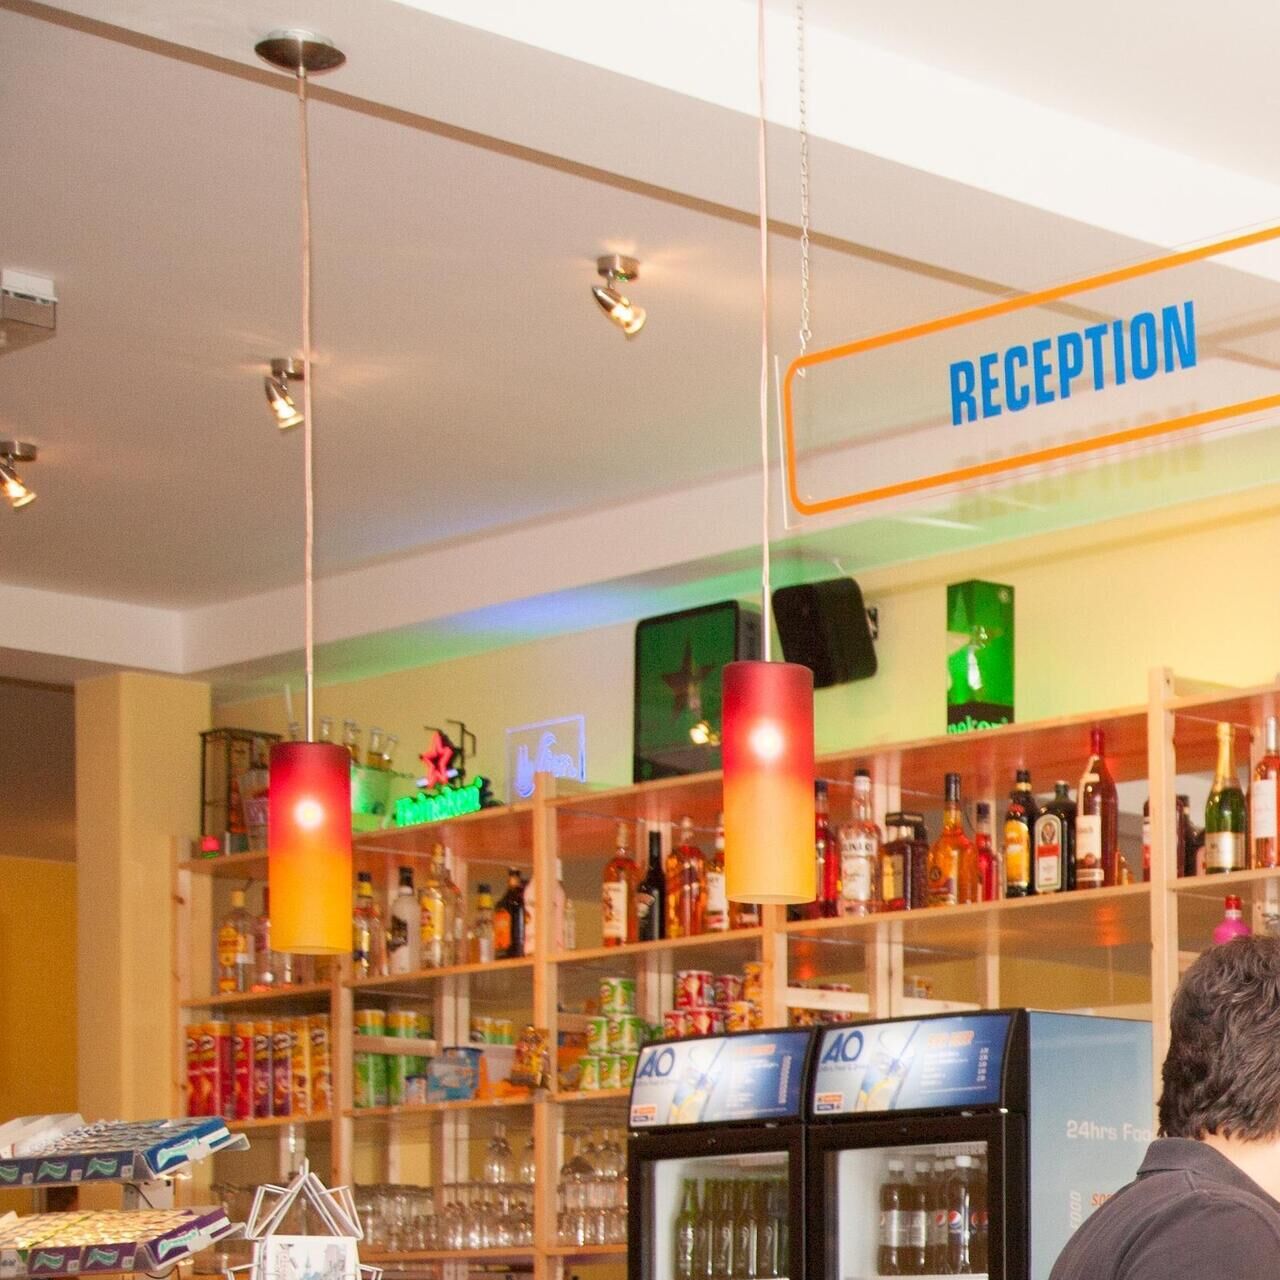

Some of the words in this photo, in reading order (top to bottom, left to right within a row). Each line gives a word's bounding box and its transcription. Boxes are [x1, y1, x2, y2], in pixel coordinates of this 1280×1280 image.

[950, 300, 1197, 426] RECEPTION
[636, 1047, 675, 1078] AO
[821, 1030, 864, 1063] AO
[1066, 1120, 1118, 1140] 24hrs
